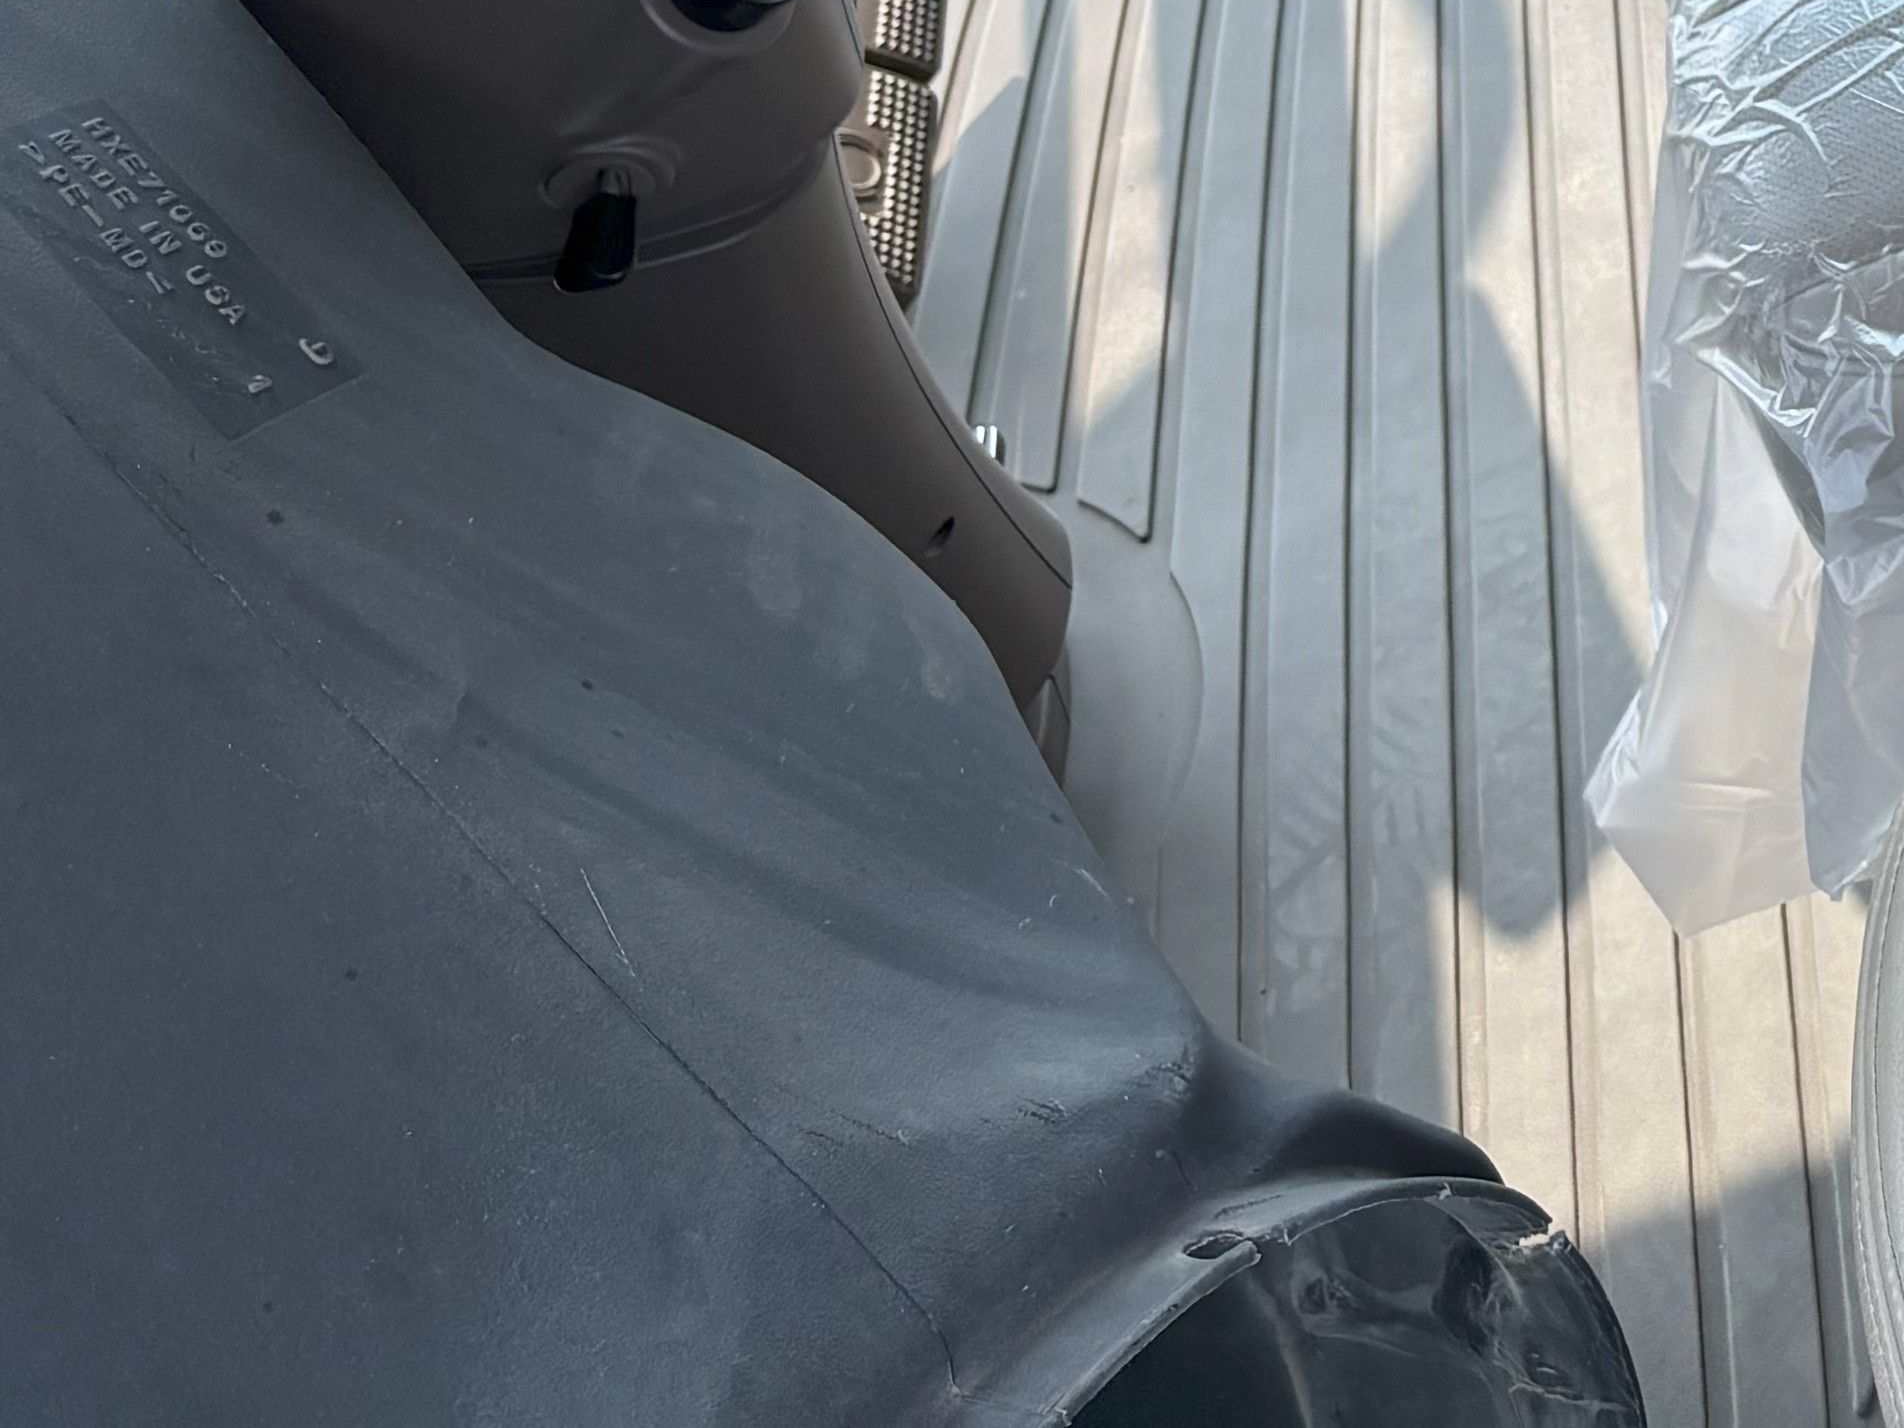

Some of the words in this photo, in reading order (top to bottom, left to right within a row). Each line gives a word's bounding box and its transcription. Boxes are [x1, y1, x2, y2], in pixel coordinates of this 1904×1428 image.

[49, 129, 139, 210] MADE
[138, 220, 182, 255] IN
[185, 265, 246, 325] USA
